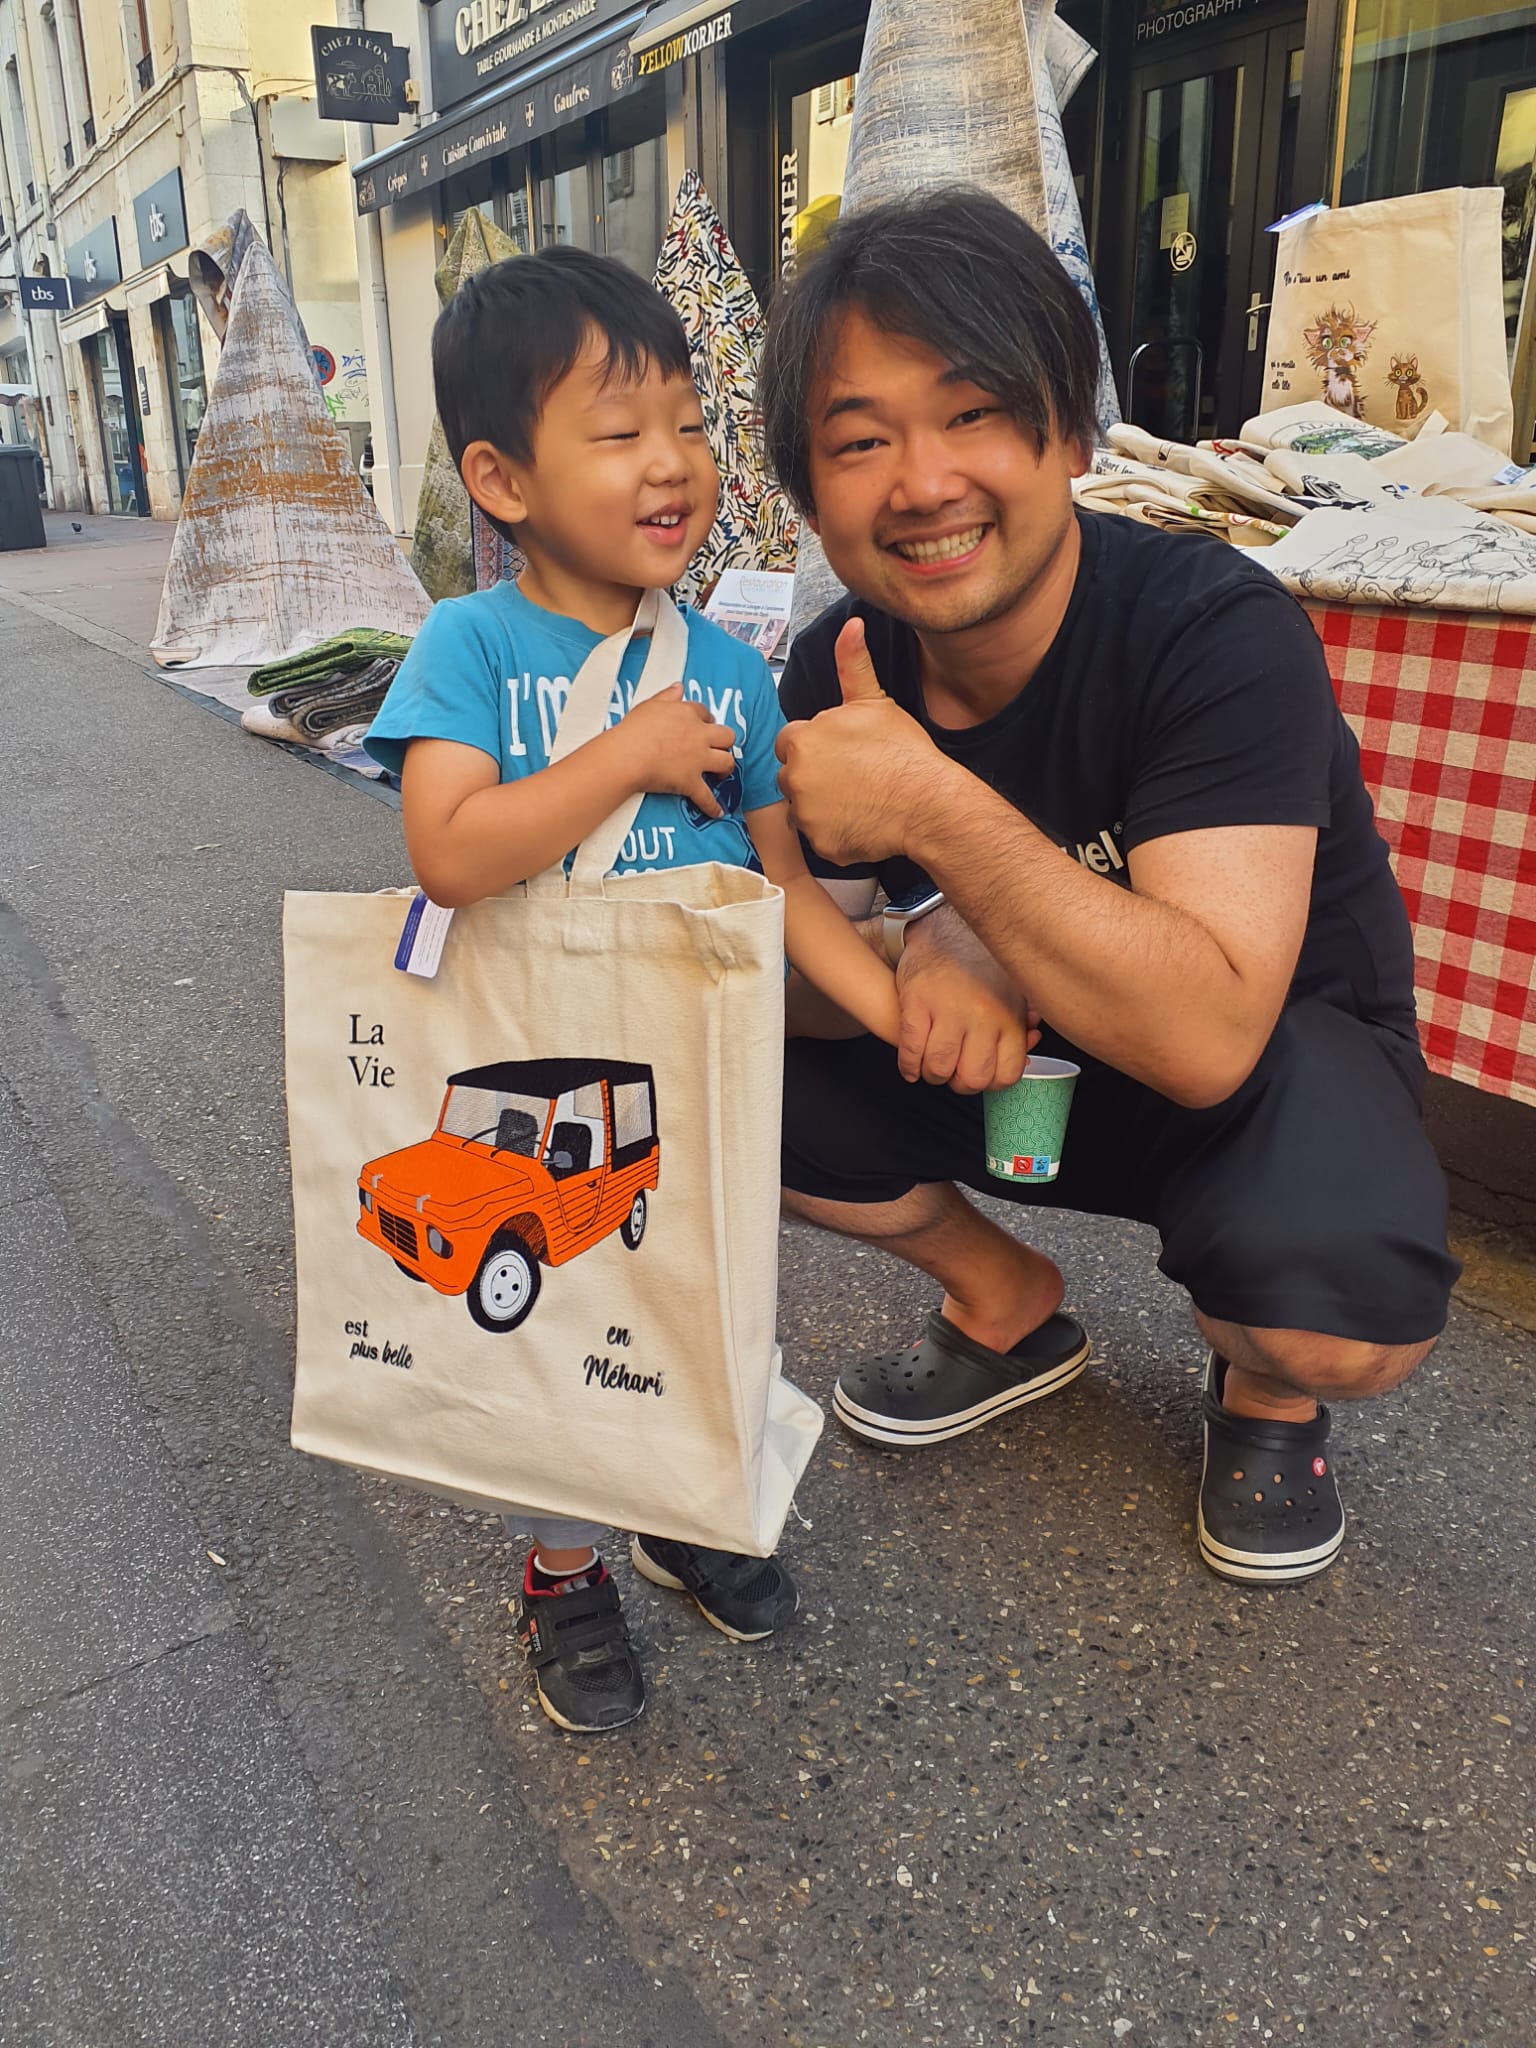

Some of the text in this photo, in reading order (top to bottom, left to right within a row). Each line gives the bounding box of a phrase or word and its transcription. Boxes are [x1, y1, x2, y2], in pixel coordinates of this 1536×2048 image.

[320, 35, 352, 57] CHEZ
[476, 54, 495, 76] TABLE
[494, 30, 536, 66] GOURMANDE
[536, 26, 542, 44] &
[541, 0, 597, 40] MONTAGNARDE
[442, 142, 467, 166] Cuisine
[468, 120, 508, 152] Conviviale
[553, 83, 591, 114] Gaufres
[149, 203, 166, 242] tbs
[31, 285, 55, 301] tbs
[349, 1014, 385, 1046] La
[348, 1055, 396, 1088] Vie
[344, 1319, 369, 1338] est
[606, 1325, 632, 1348] en
[349, 1339, 414, 1369] plus belle
[583, 1354, 665, 1397] Méhari
